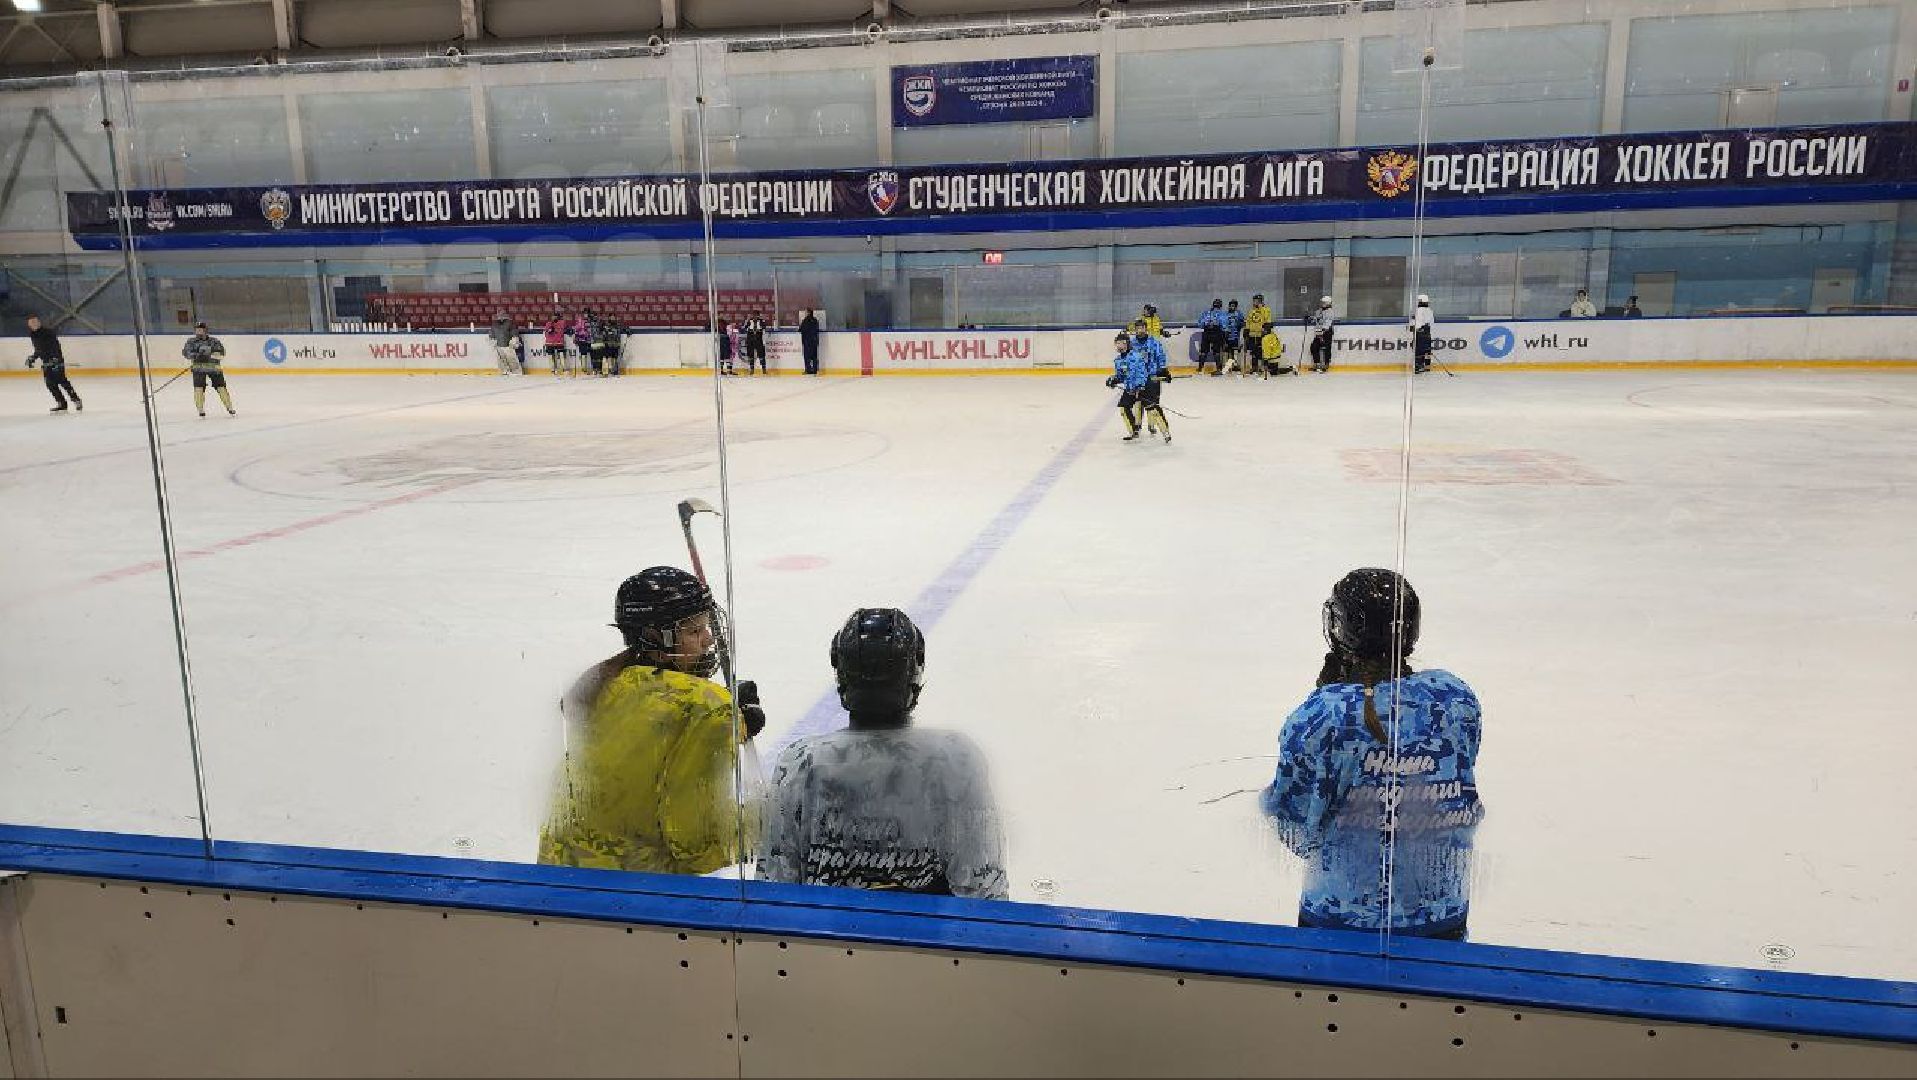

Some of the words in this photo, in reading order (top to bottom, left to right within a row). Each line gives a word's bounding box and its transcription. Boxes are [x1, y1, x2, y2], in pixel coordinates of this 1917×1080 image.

[1423, 146, 1598, 193] ФЕДЕРАЦИЯ
[1614, 141, 1730, 183] ХОККЕЯ
[1746, 135, 1868, 179] РОССИИ
[909, 170, 1085, 212] СТУДЕНЧЕСКАЯ
[1099, 160, 1245, 203] ХОККЕЙНАЯ
[1260, 160, 1324, 198] ЛИГА
[301, 190, 451, 224] МИНИСТЕРСТВО
[462, 187, 541, 220] СПОРТА
[552, 178, 688, 218] РОССИЙСКОЙ
[699, 179, 833, 218] ФЕДЕРАЦИИ
[293, 345, 336, 360] whl_ru
[369, 342, 469, 360] WHL.KHL.RU
[885, 337, 1031, 361] WHL.KHL.RU
[1524, 333, 1590, 351] whl_ru
